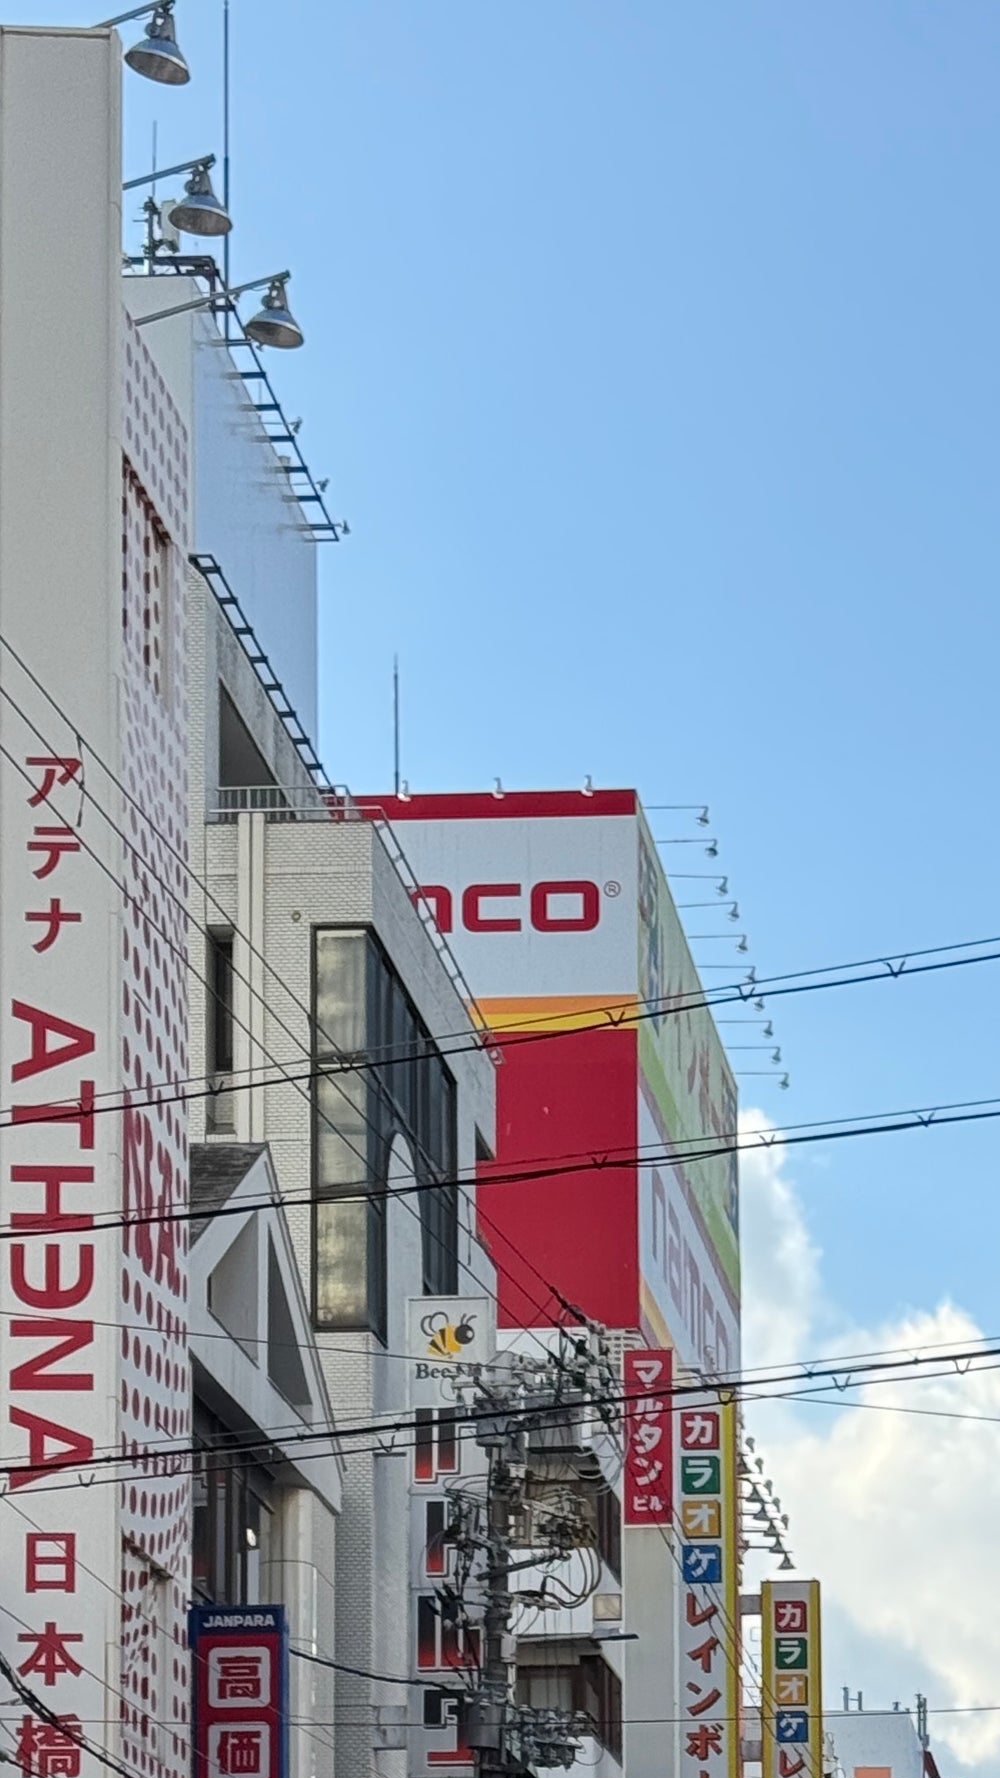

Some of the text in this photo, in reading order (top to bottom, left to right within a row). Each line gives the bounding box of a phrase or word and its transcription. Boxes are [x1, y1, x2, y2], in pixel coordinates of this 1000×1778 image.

[25, 756, 84, 954] アテナ
[9, 999, 96, 1490] ATHENA
[632, 1360, 664, 1487] マルタン
[684, 1415, 717, 1577] カラオケ
[203, 1614, 275, 1628] JANPARA
[778, 1605, 805, 1737] カラオケ
